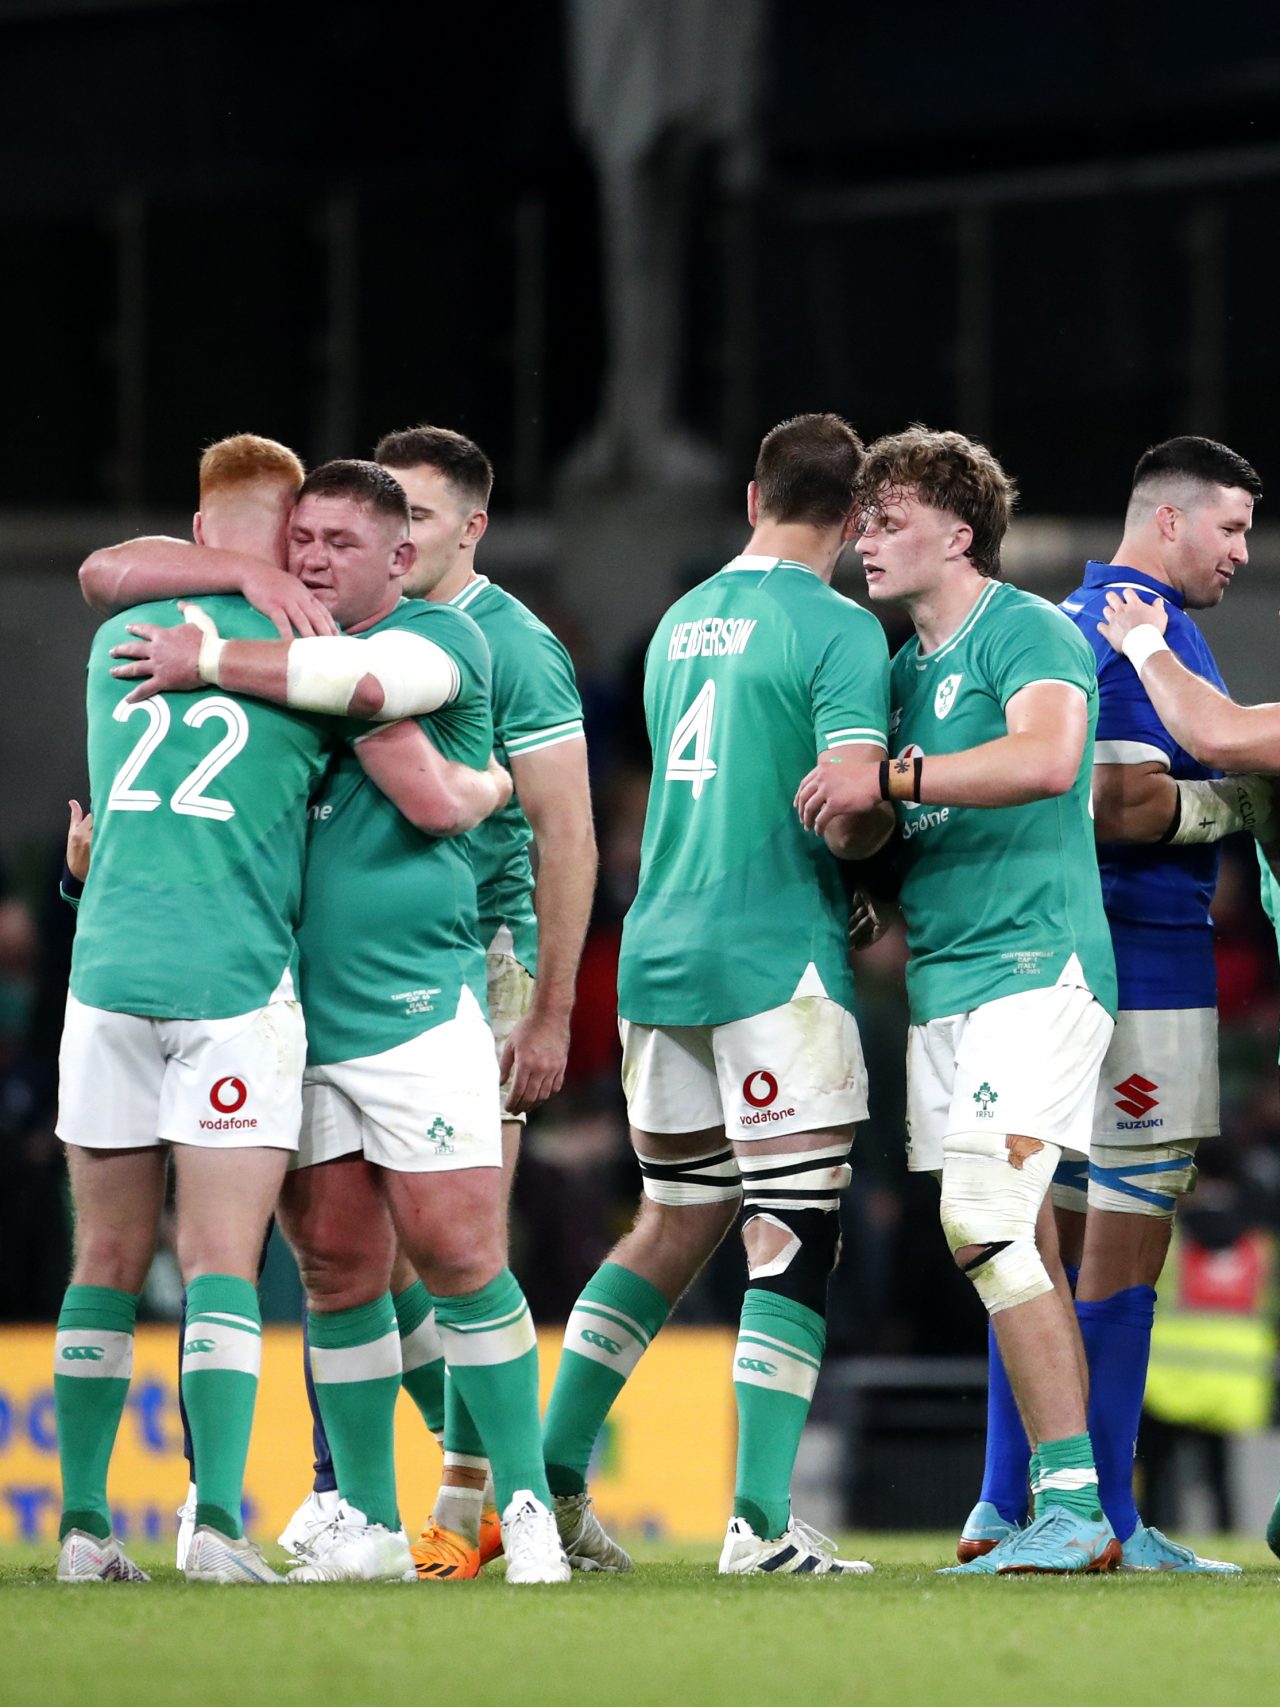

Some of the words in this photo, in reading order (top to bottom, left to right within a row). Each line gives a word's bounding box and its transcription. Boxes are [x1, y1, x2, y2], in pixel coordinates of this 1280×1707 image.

[665, 678, 718, 800] 4
[108, 694, 249, 821] 22
[199, 1117, 258, 1130] vodafone
[739, 1107, 796, 1125] vodafone
[1116, 1118, 1164, 1130] SUZUKI
